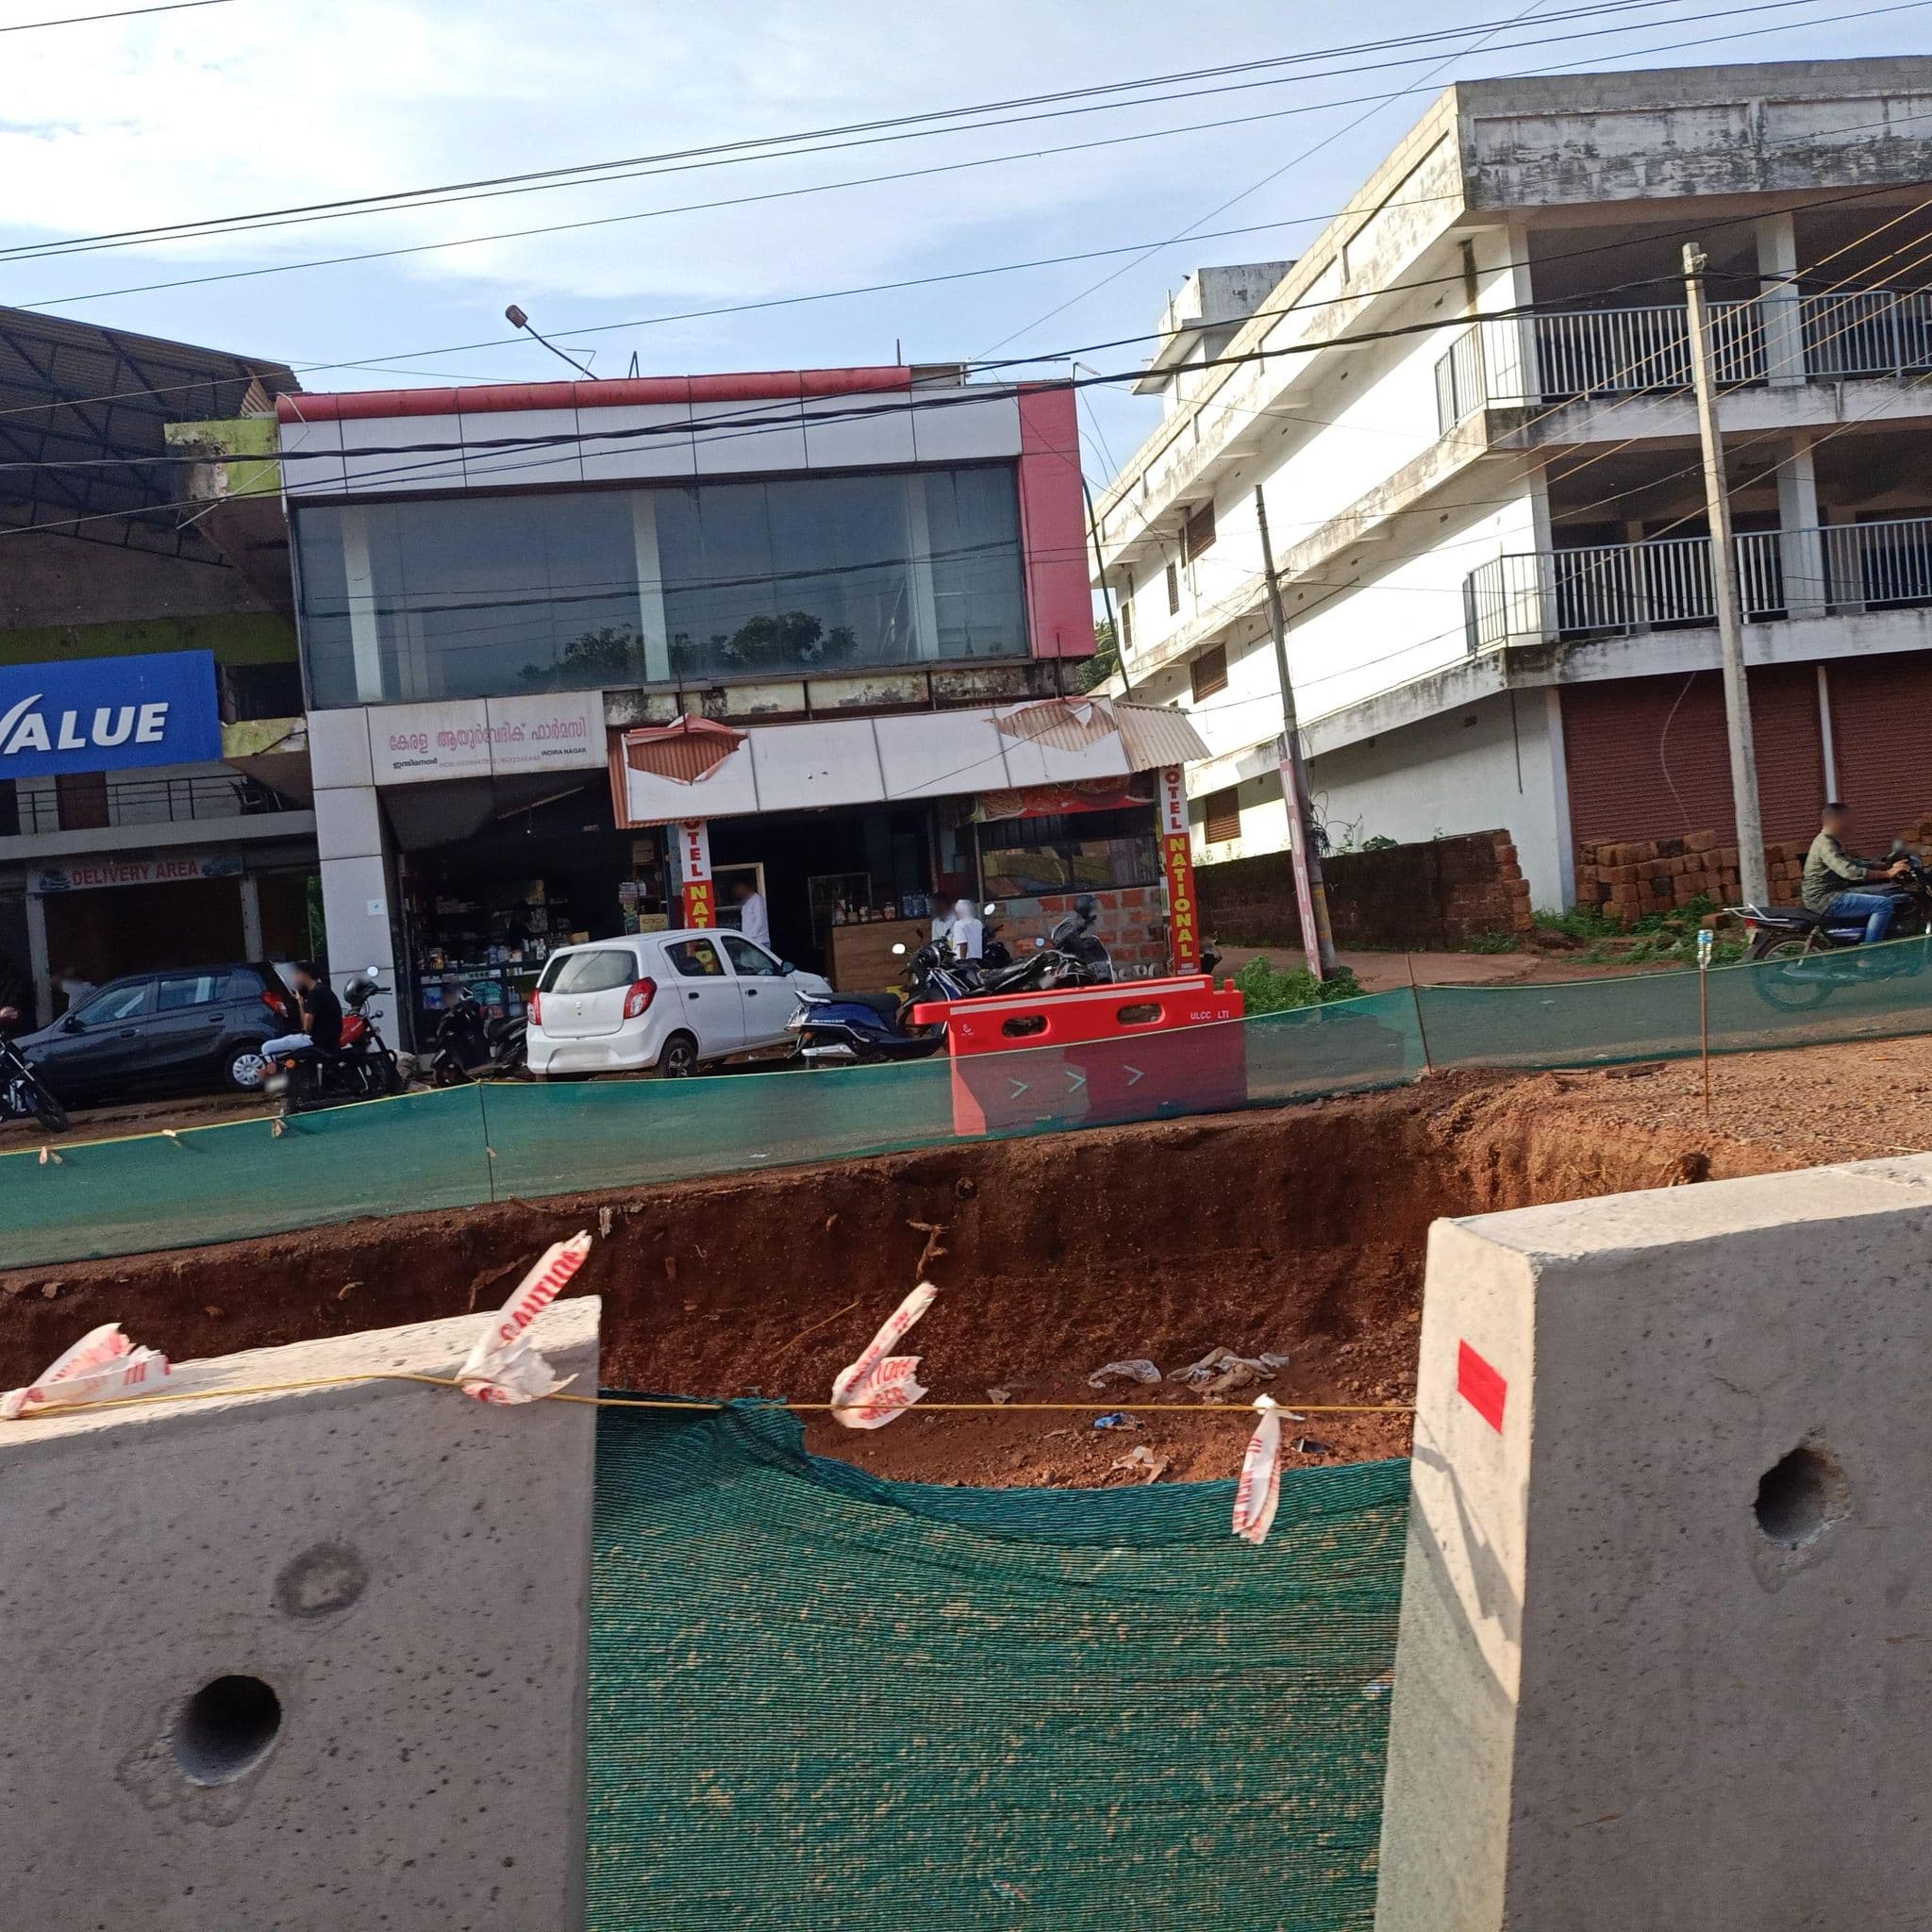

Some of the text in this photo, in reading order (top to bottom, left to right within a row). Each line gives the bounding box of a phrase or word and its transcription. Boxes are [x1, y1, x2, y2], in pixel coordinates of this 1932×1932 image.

[389, 731, 429, 754] കേരള
[541, 747, 587, 757] INDIRA NAGAR
[1165, 765, 1182, 830] OTEL
[72, 859, 198, 886] DELIVERY AREA
[1170, 838, 1192, 958] NATIONAL
[1190, 1011, 1211, 1020] ULCC
[500, 1251, 586, 1341] CAUTION
